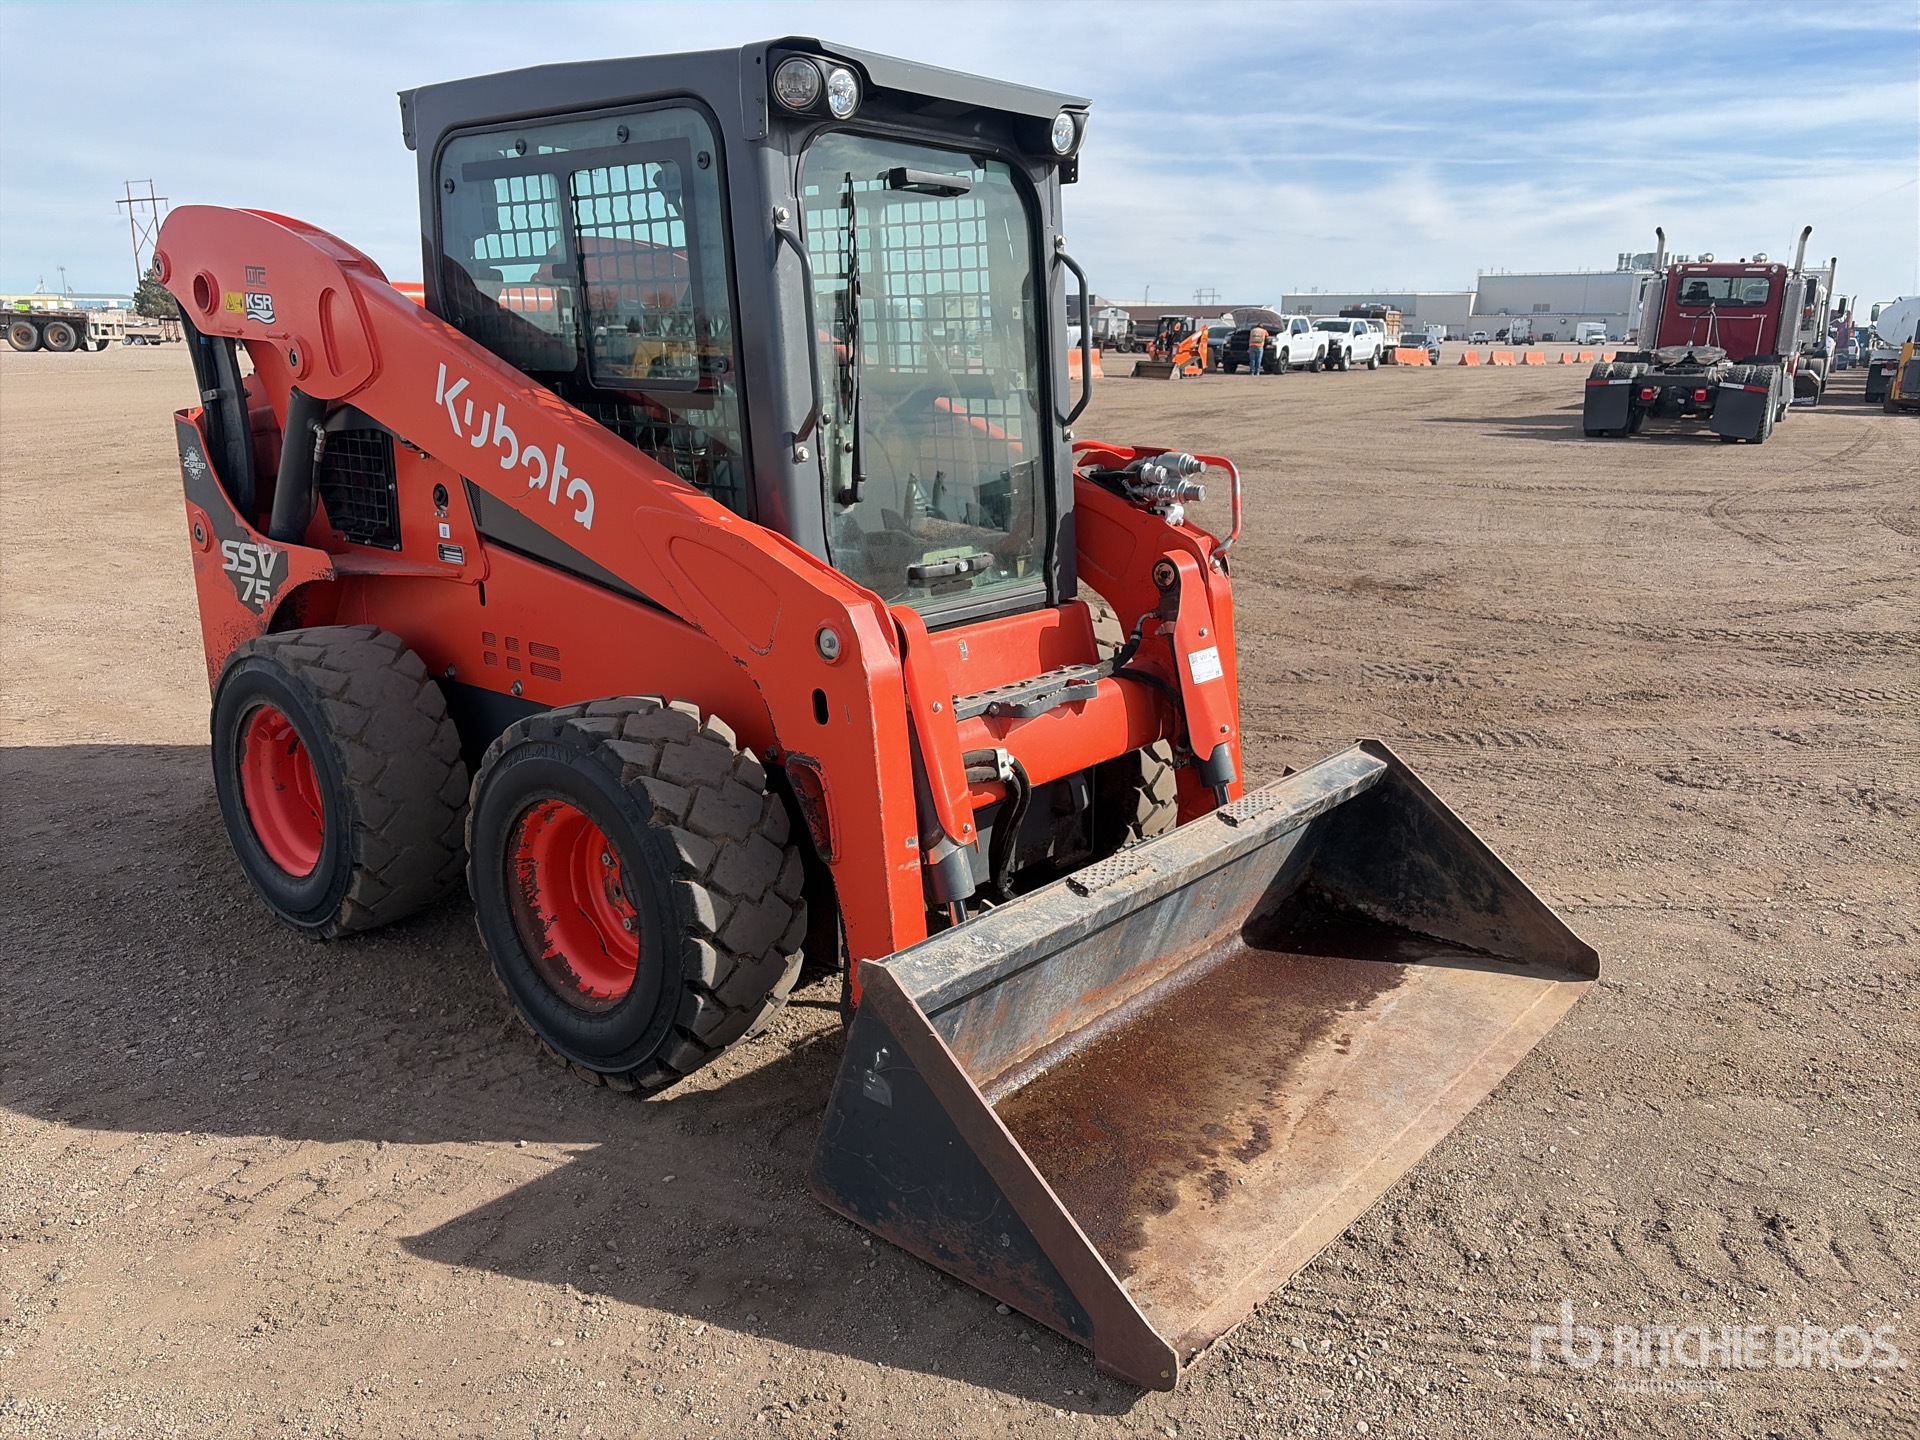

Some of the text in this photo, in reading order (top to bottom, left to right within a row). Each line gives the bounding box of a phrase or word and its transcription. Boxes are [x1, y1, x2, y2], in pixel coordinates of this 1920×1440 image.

[245, 293, 273, 311] KSR
[435, 362, 595, 531] Kubota
[221, 540, 278, 578] SSV
[240, 575, 271, 606] 75
[503, 743, 580, 770] GALAXY
